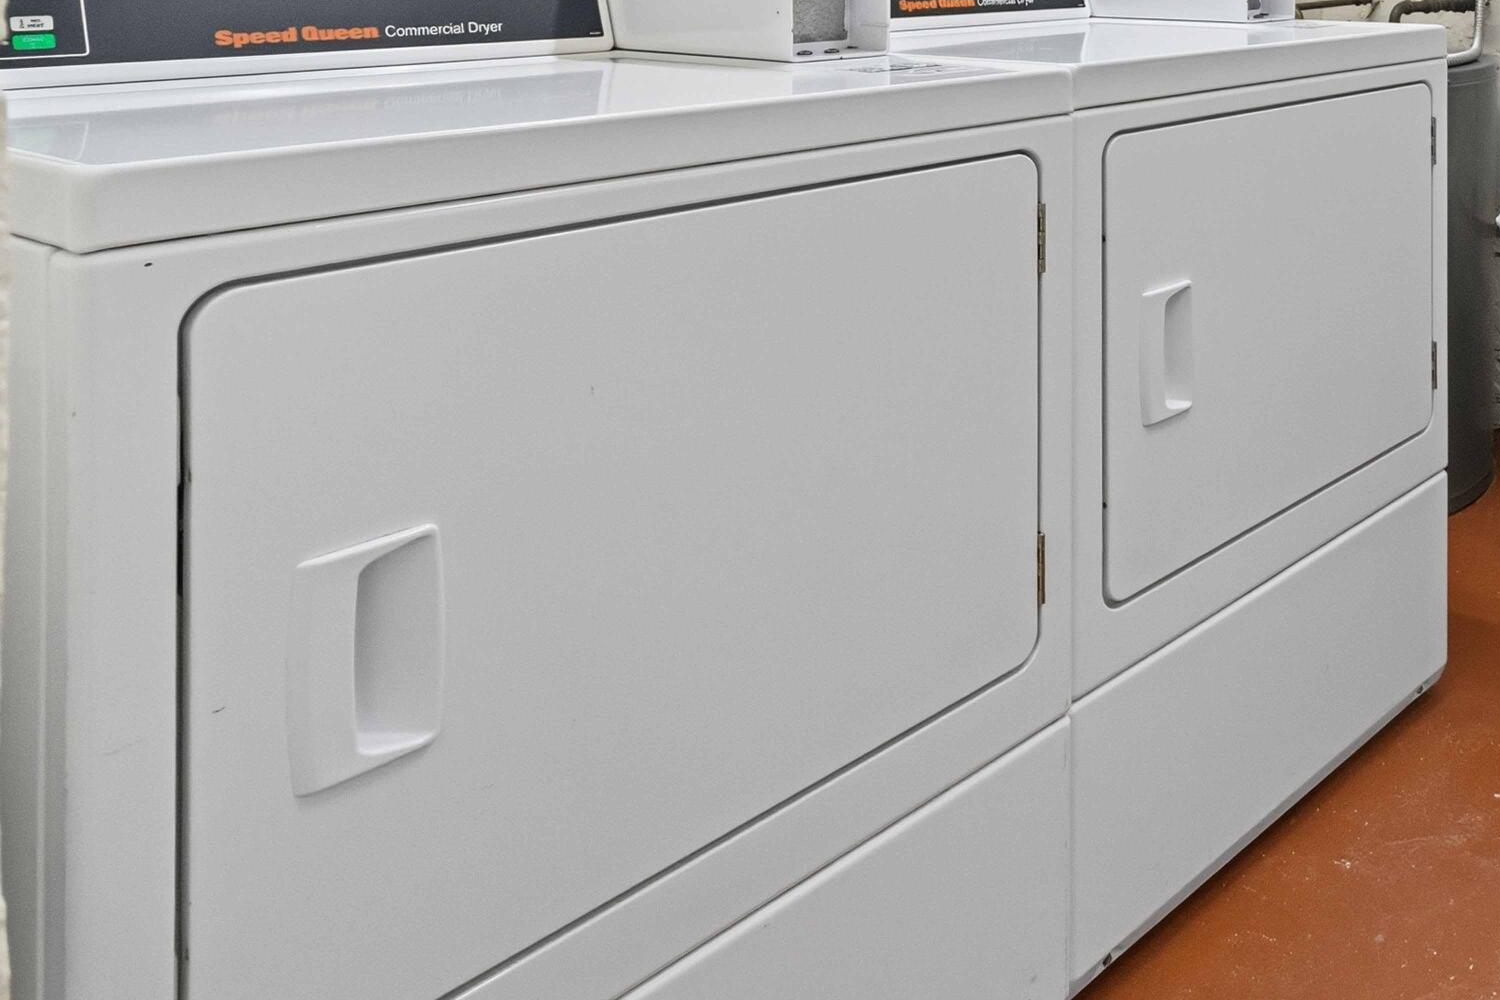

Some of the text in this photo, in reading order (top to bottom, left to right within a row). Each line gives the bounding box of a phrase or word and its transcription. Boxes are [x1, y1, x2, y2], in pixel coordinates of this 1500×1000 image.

[214, 21, 503, 48] Speed Queen Commercial Dryer
